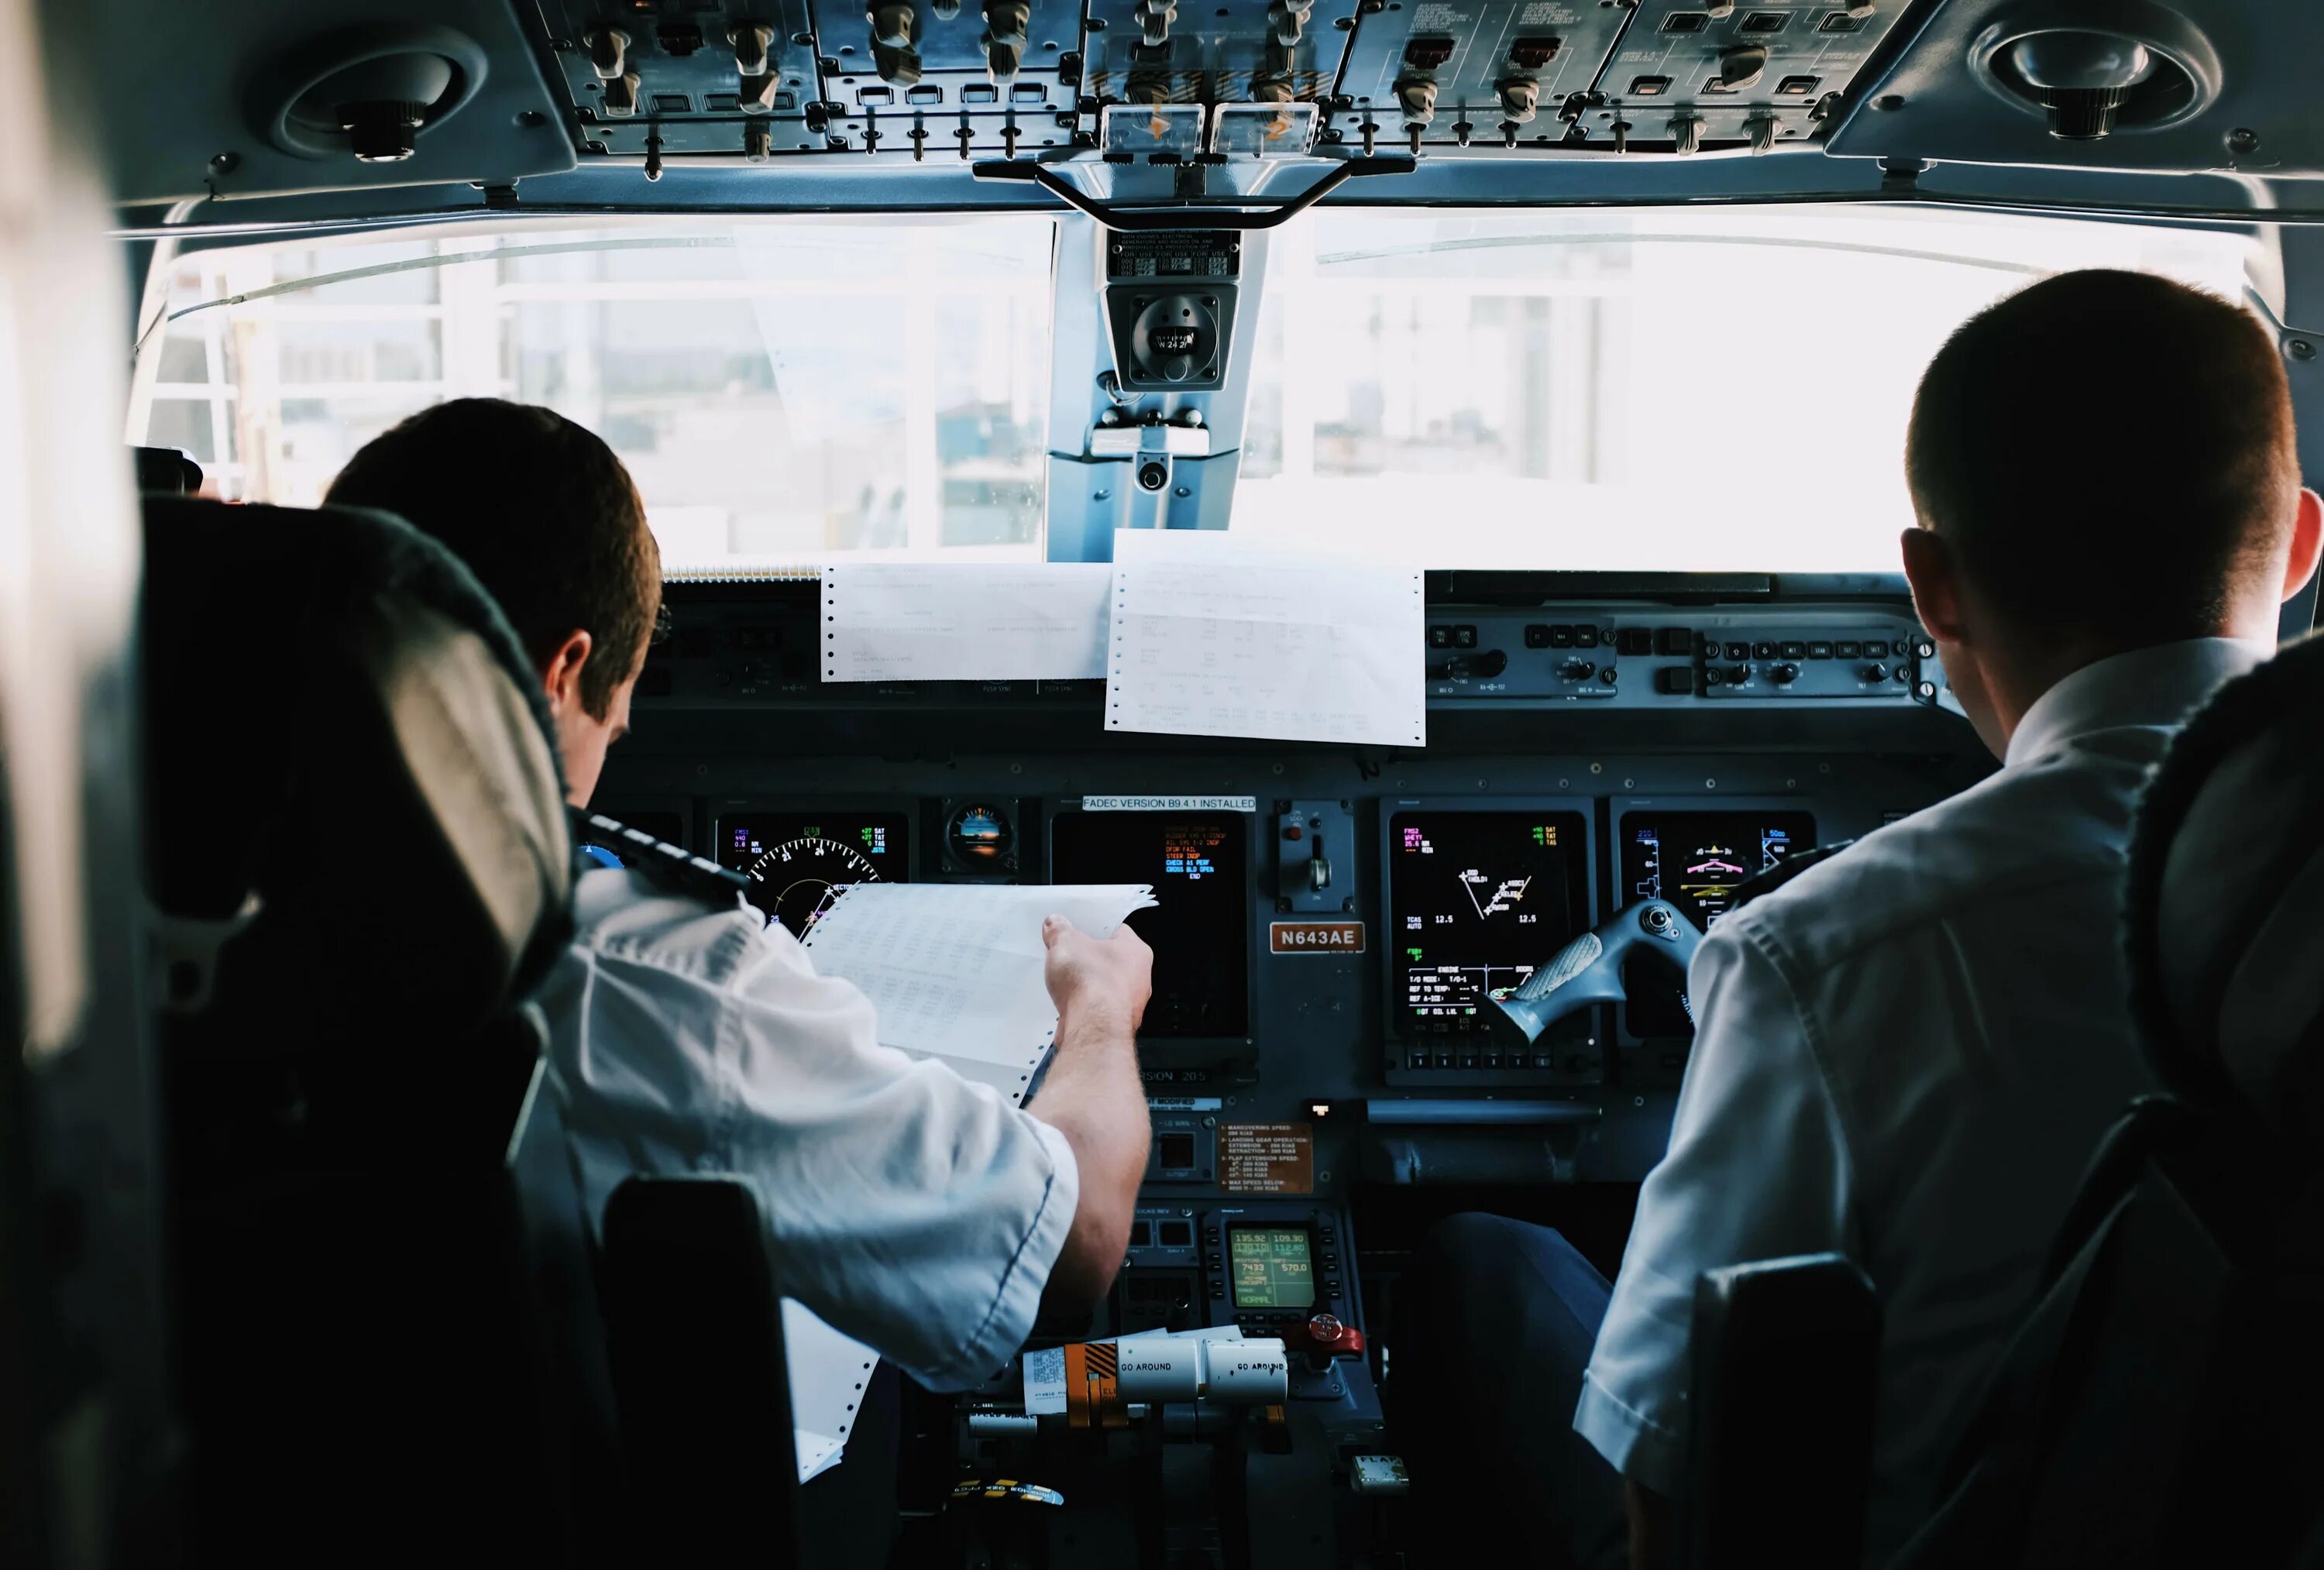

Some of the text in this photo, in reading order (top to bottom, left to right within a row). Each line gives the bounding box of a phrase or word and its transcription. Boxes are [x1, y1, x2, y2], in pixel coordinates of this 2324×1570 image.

[1266, 121, 1287, 140] 2
[1084, 799, 1256, 808] FADEC VERSION B9.4.1 INSTALLED
[1281, 929, 1355, 945] N643AE
[1122, 1362, 1171, 1371] GO AROUND
